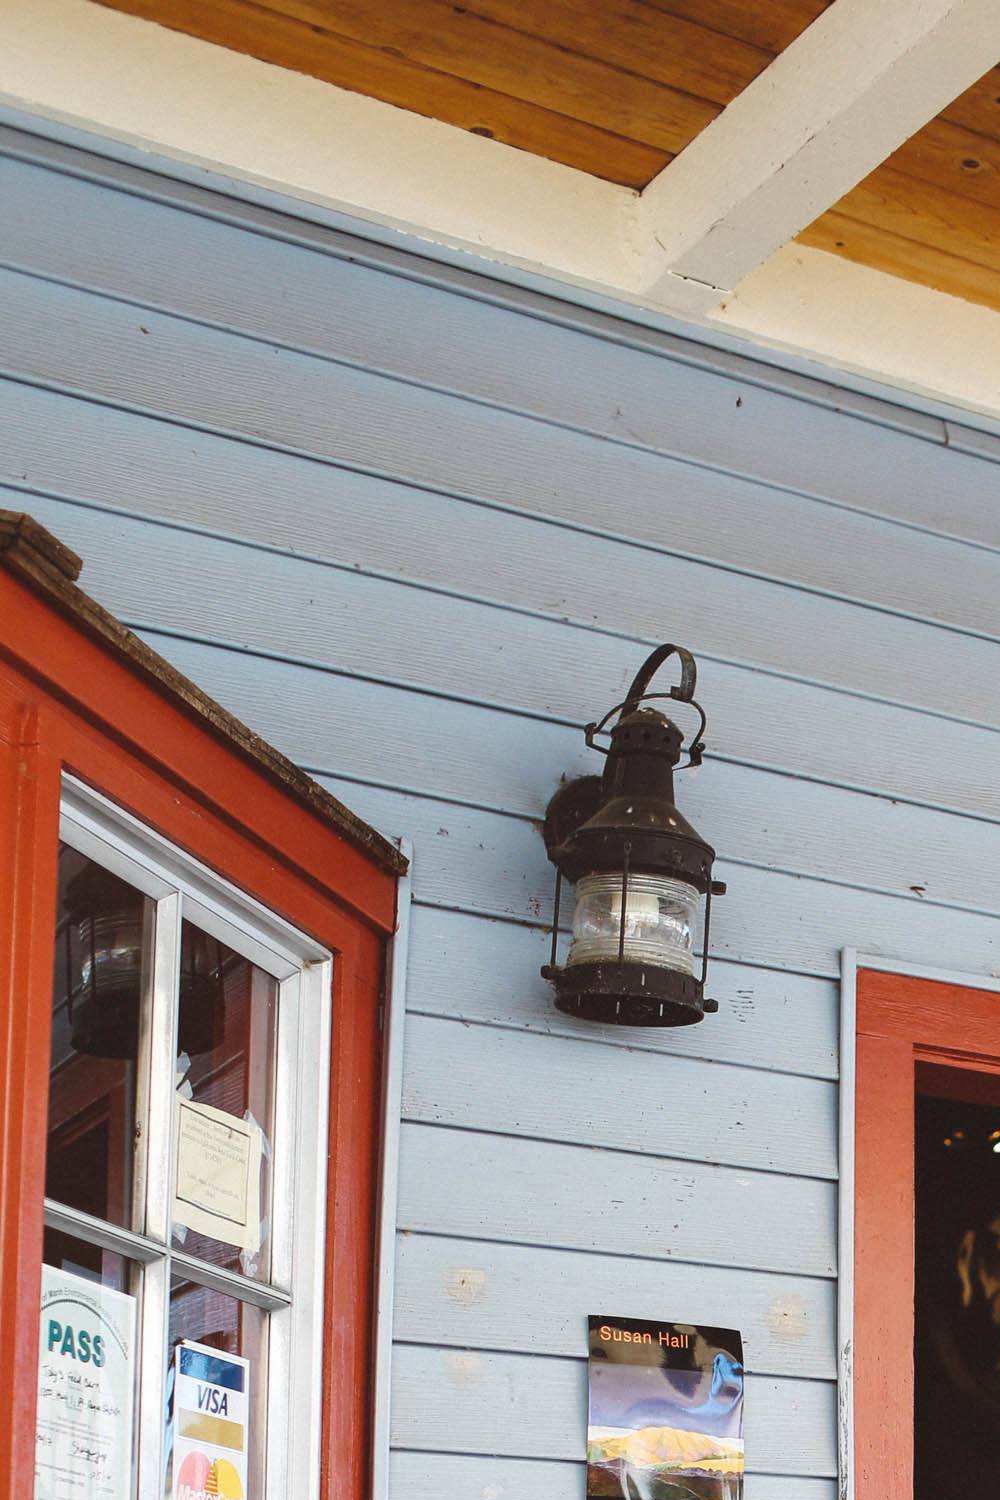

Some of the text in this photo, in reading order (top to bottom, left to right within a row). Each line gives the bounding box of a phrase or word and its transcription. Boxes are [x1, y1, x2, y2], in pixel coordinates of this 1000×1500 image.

[48, 1319, 106, 1368] PASS
[600, 1325, 689, 1349] Susan Hall
[197, 1384, 228, 1417] VISA
